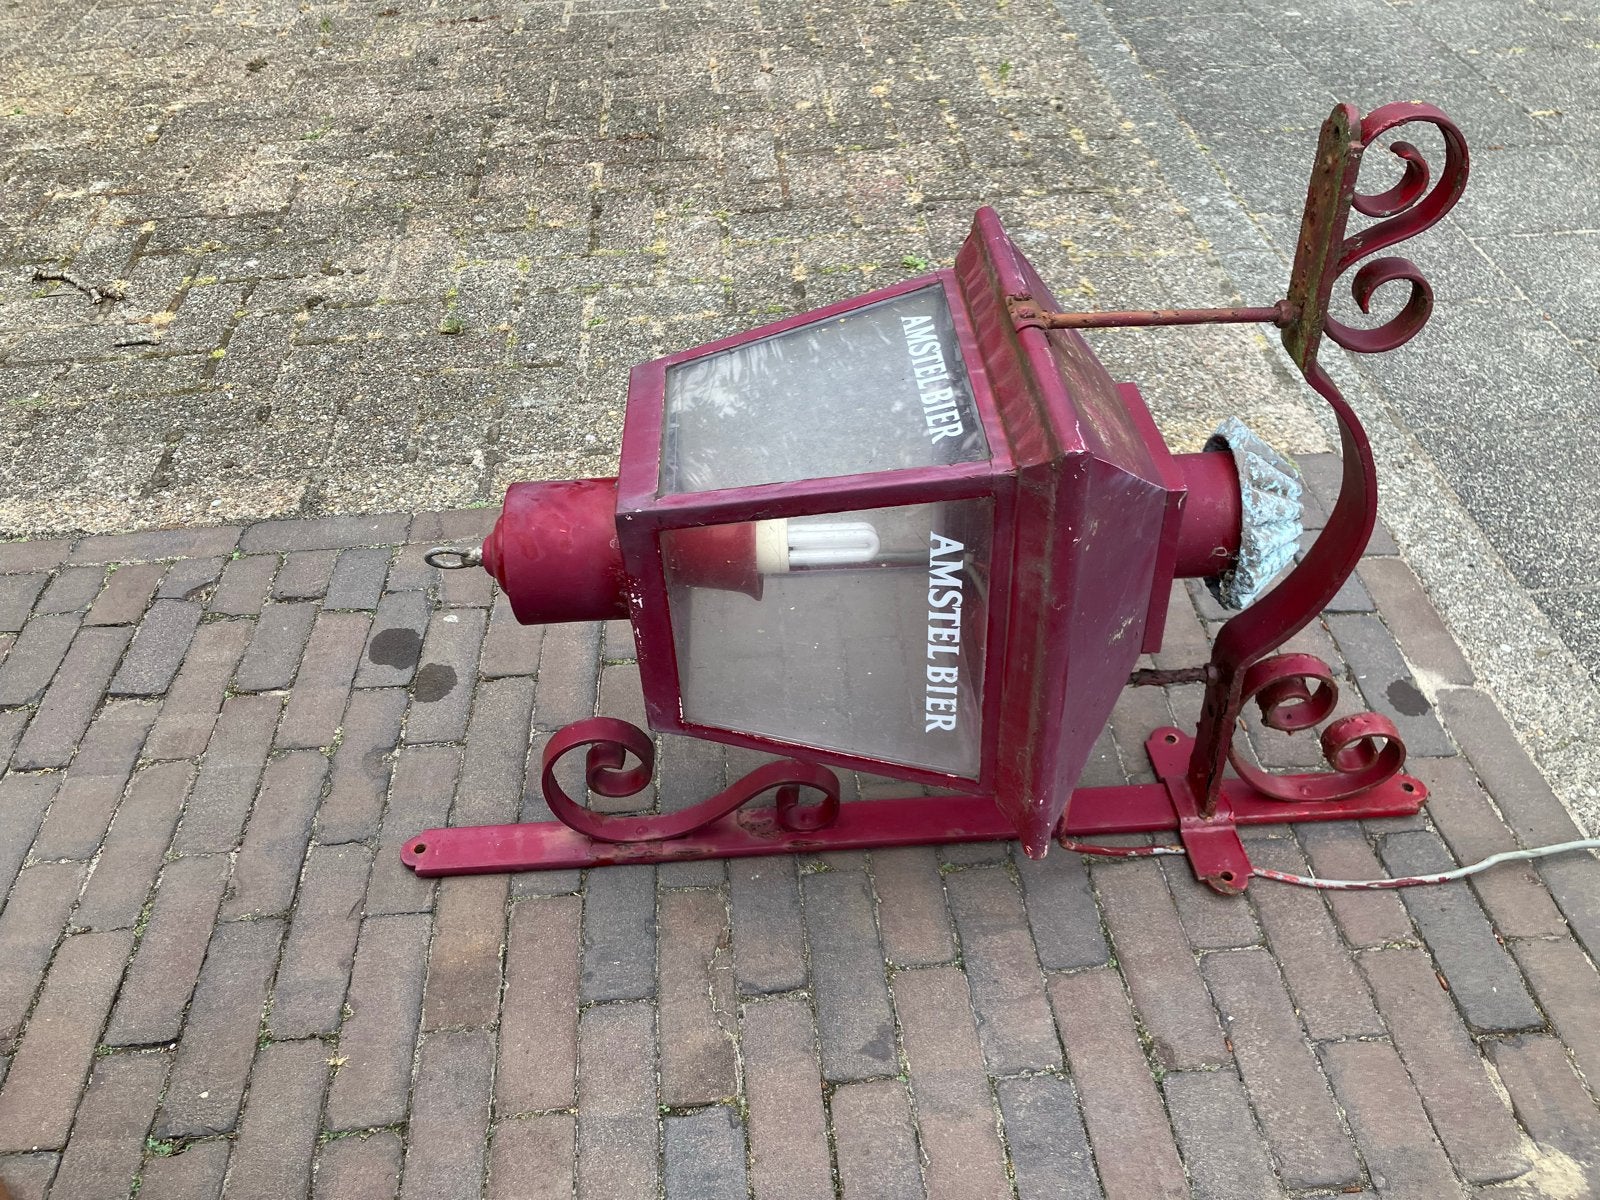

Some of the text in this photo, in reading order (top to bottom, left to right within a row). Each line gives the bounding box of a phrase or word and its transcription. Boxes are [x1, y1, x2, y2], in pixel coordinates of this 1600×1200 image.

[900, 315, 964, 445] AMSTEL BIER
[925, 530, 965, 734] AMSTEL BIER
